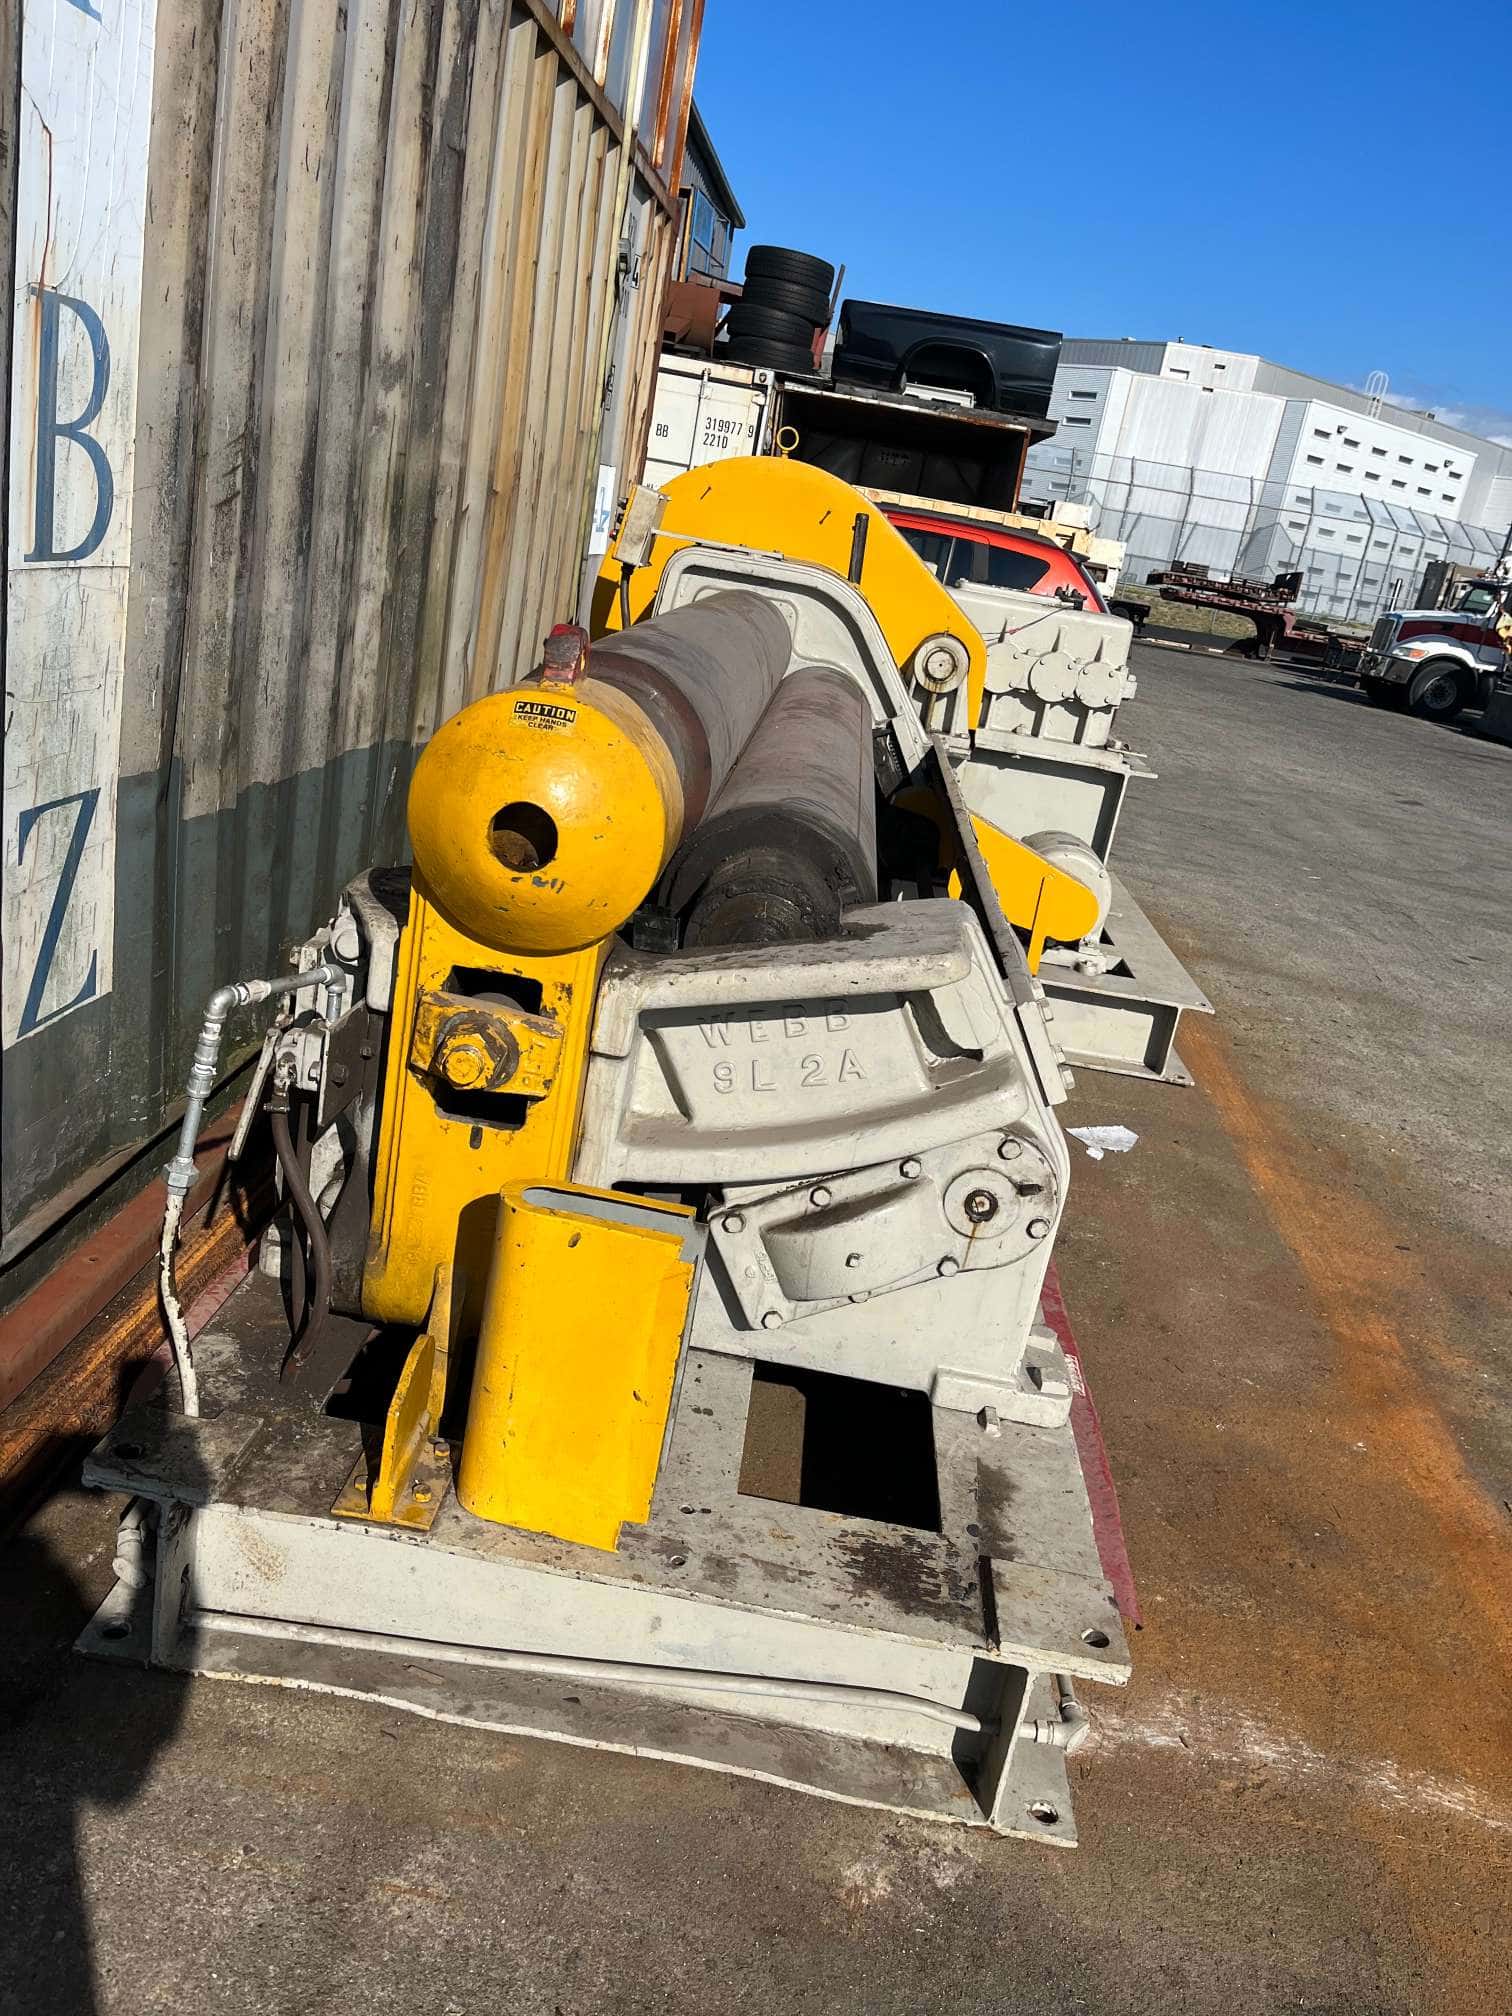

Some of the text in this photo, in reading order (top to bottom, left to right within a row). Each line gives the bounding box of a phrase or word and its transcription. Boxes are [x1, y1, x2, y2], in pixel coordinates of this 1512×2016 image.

[24, 286, 114, 562] B
[705, 417, 754, 438] 319977 9
[703, 433, 728, 448] 2210
[515, 702, 575, 721] CAUTION
[527, 721, 554, 731] CLEAR
[540, 716, 567, 728] HANDS
[696, 999, 851, 1048] WEBB
